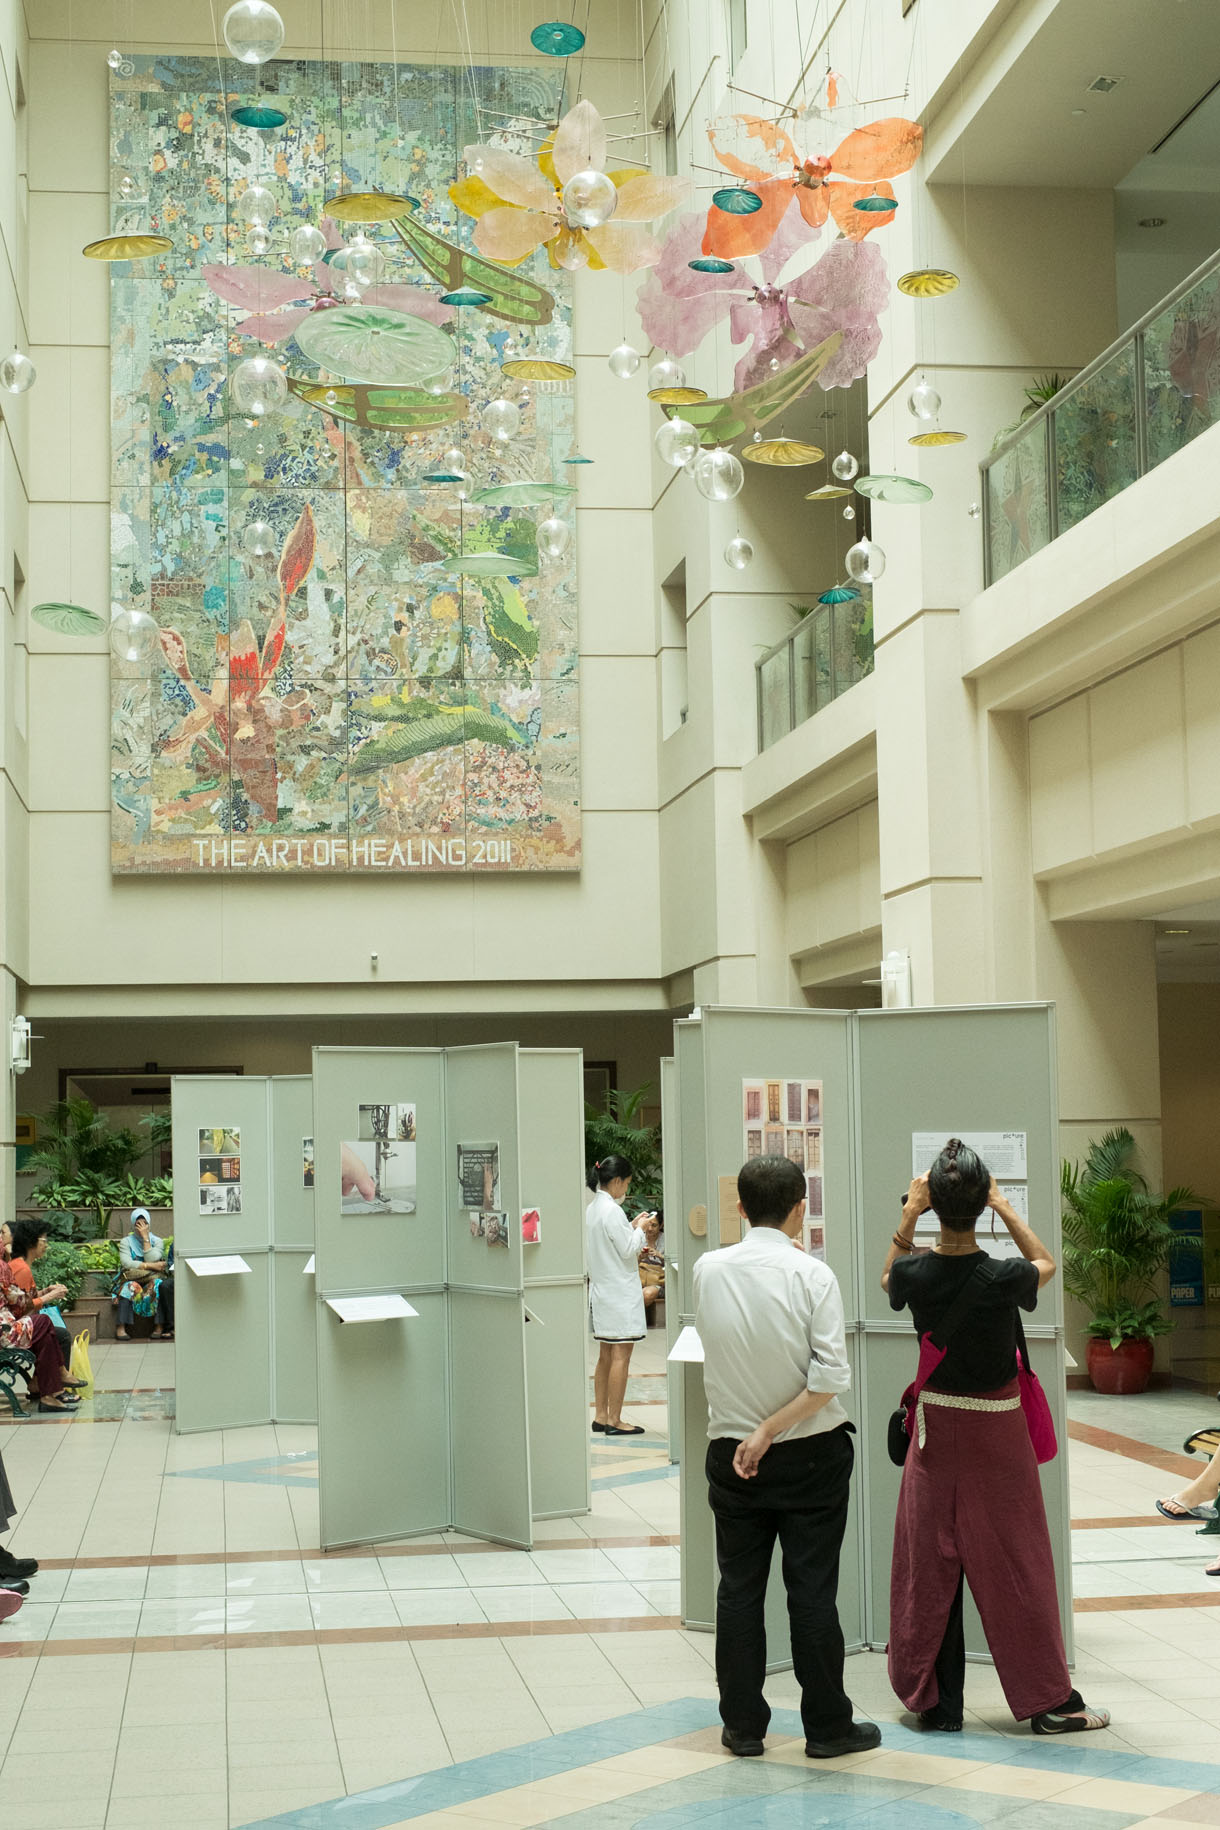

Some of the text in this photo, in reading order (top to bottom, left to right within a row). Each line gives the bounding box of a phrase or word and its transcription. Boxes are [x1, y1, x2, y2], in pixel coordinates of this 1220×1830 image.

[193, 839, 512, 867] THE ART OF HEALING 2011
[1171, 1287, 1195, 1299] PAPER
